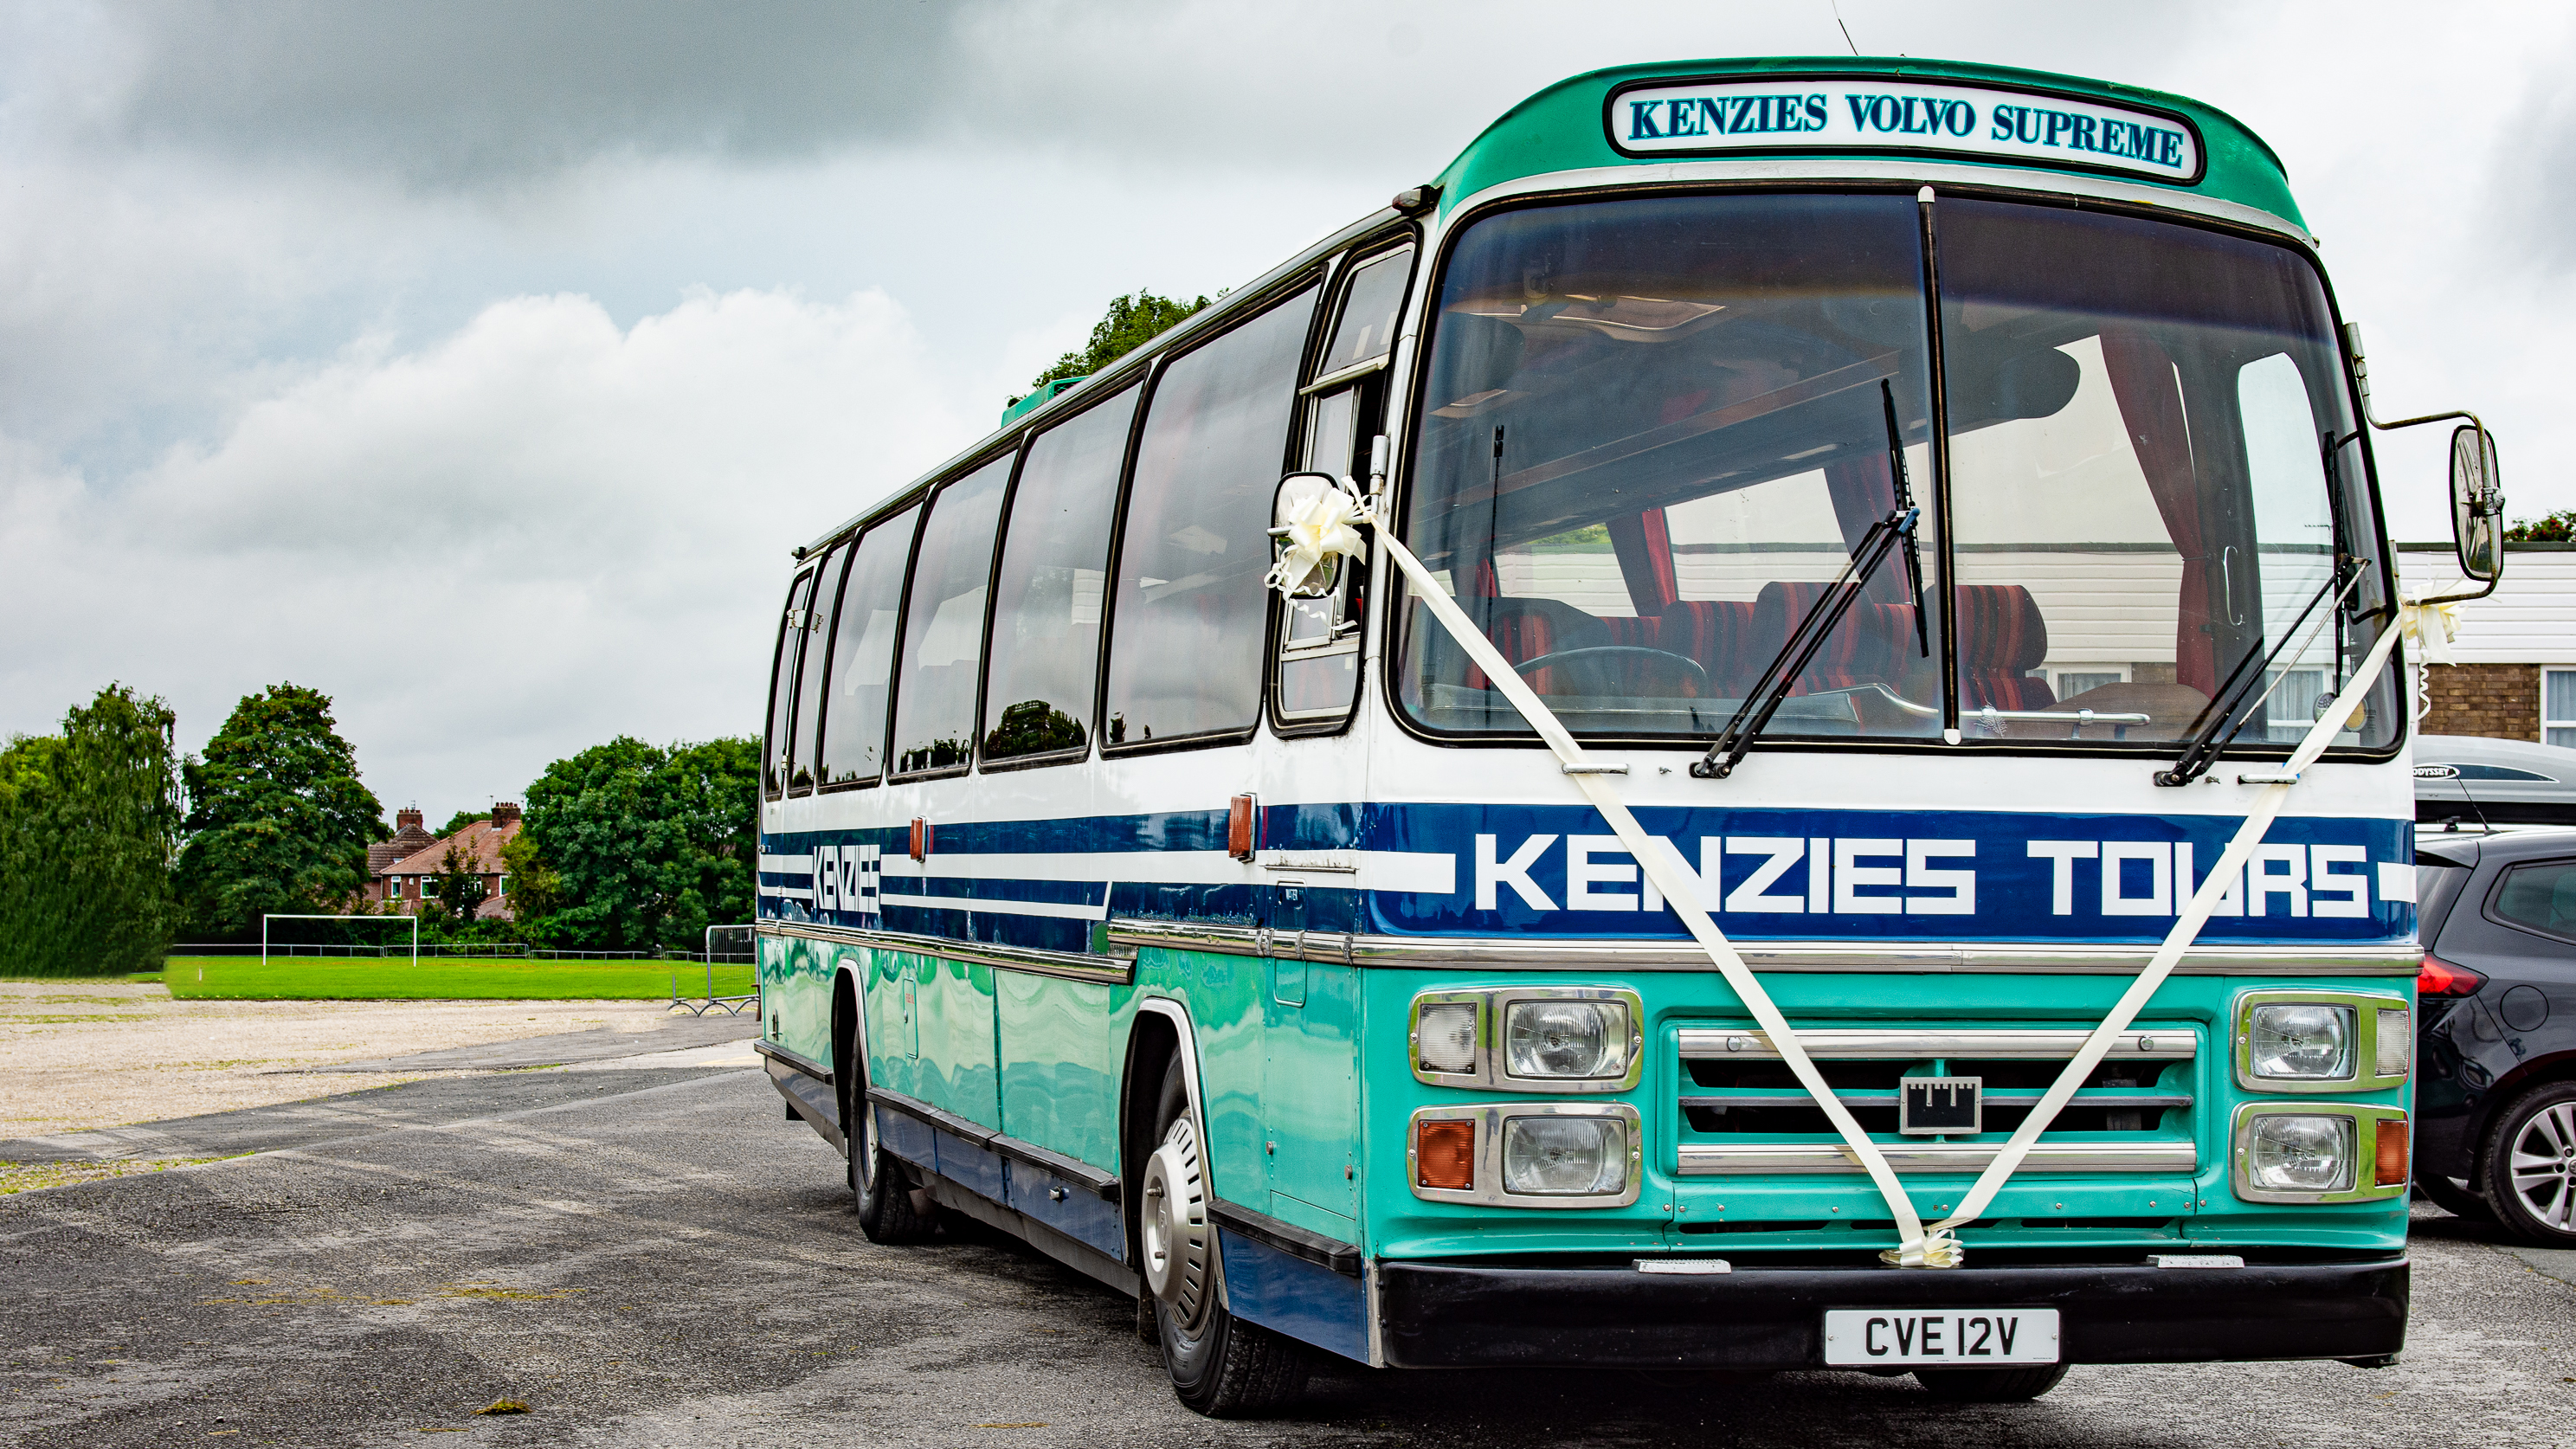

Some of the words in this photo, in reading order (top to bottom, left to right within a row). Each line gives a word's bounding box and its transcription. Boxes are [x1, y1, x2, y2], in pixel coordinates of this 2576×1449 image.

[1628, 93, 1827, 141] KENZIES
[1845, 94, 1977, 137] VOLVO
[1992, 104, 2185, 169] SUPREME
[2412, 767, 2450, 776] ODYSSEY
[814, 844, 880, 913] KENZIES
[1475, 834, 1976, 915] KENZIES
[2026, 840, 2369, 918] TOURS
[1865, 1316, 1945, 1356] CVE
[1957, 1317, 2019, 1356] 12V
